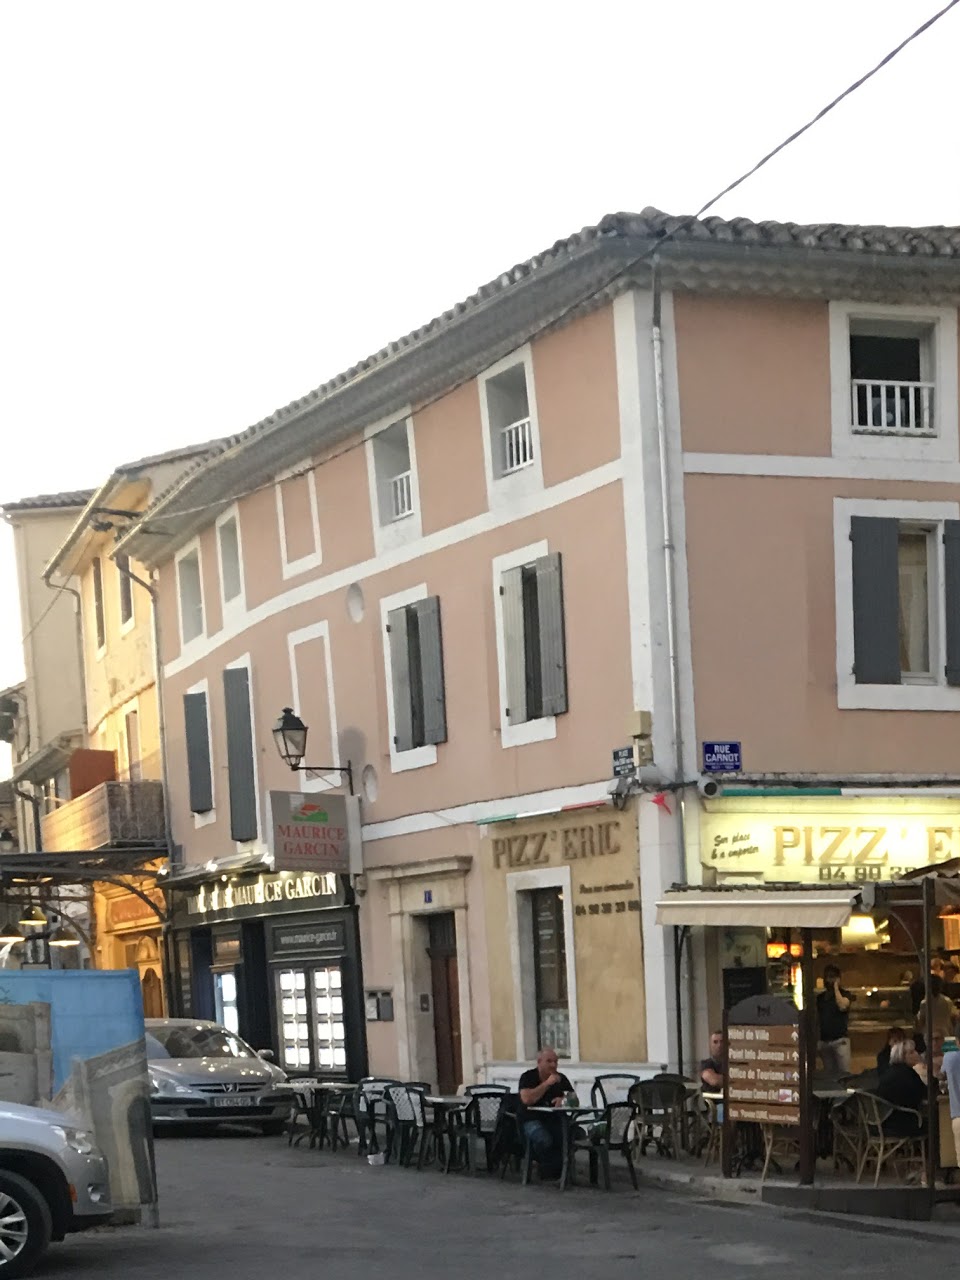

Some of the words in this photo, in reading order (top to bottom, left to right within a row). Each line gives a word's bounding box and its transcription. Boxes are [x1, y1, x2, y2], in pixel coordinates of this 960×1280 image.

[714, 745, 731, 754] RUE
[706, 753, 739, 762] CARNOT
[278, 825, 345, 841] MAURICE
[284, 841, 340, 857] GARCIN
[819, 866, 846, 881] 04
[285, 873, 337, 900] GARCIN
[746, 1030, 754, 1040] de
[755, 1030, 769, 1041] Ville
[729, 1067, 746, 1079] Office
[747, 1069, 755, 1079] de
[757, 1069, 785, 1081] Tourisme
